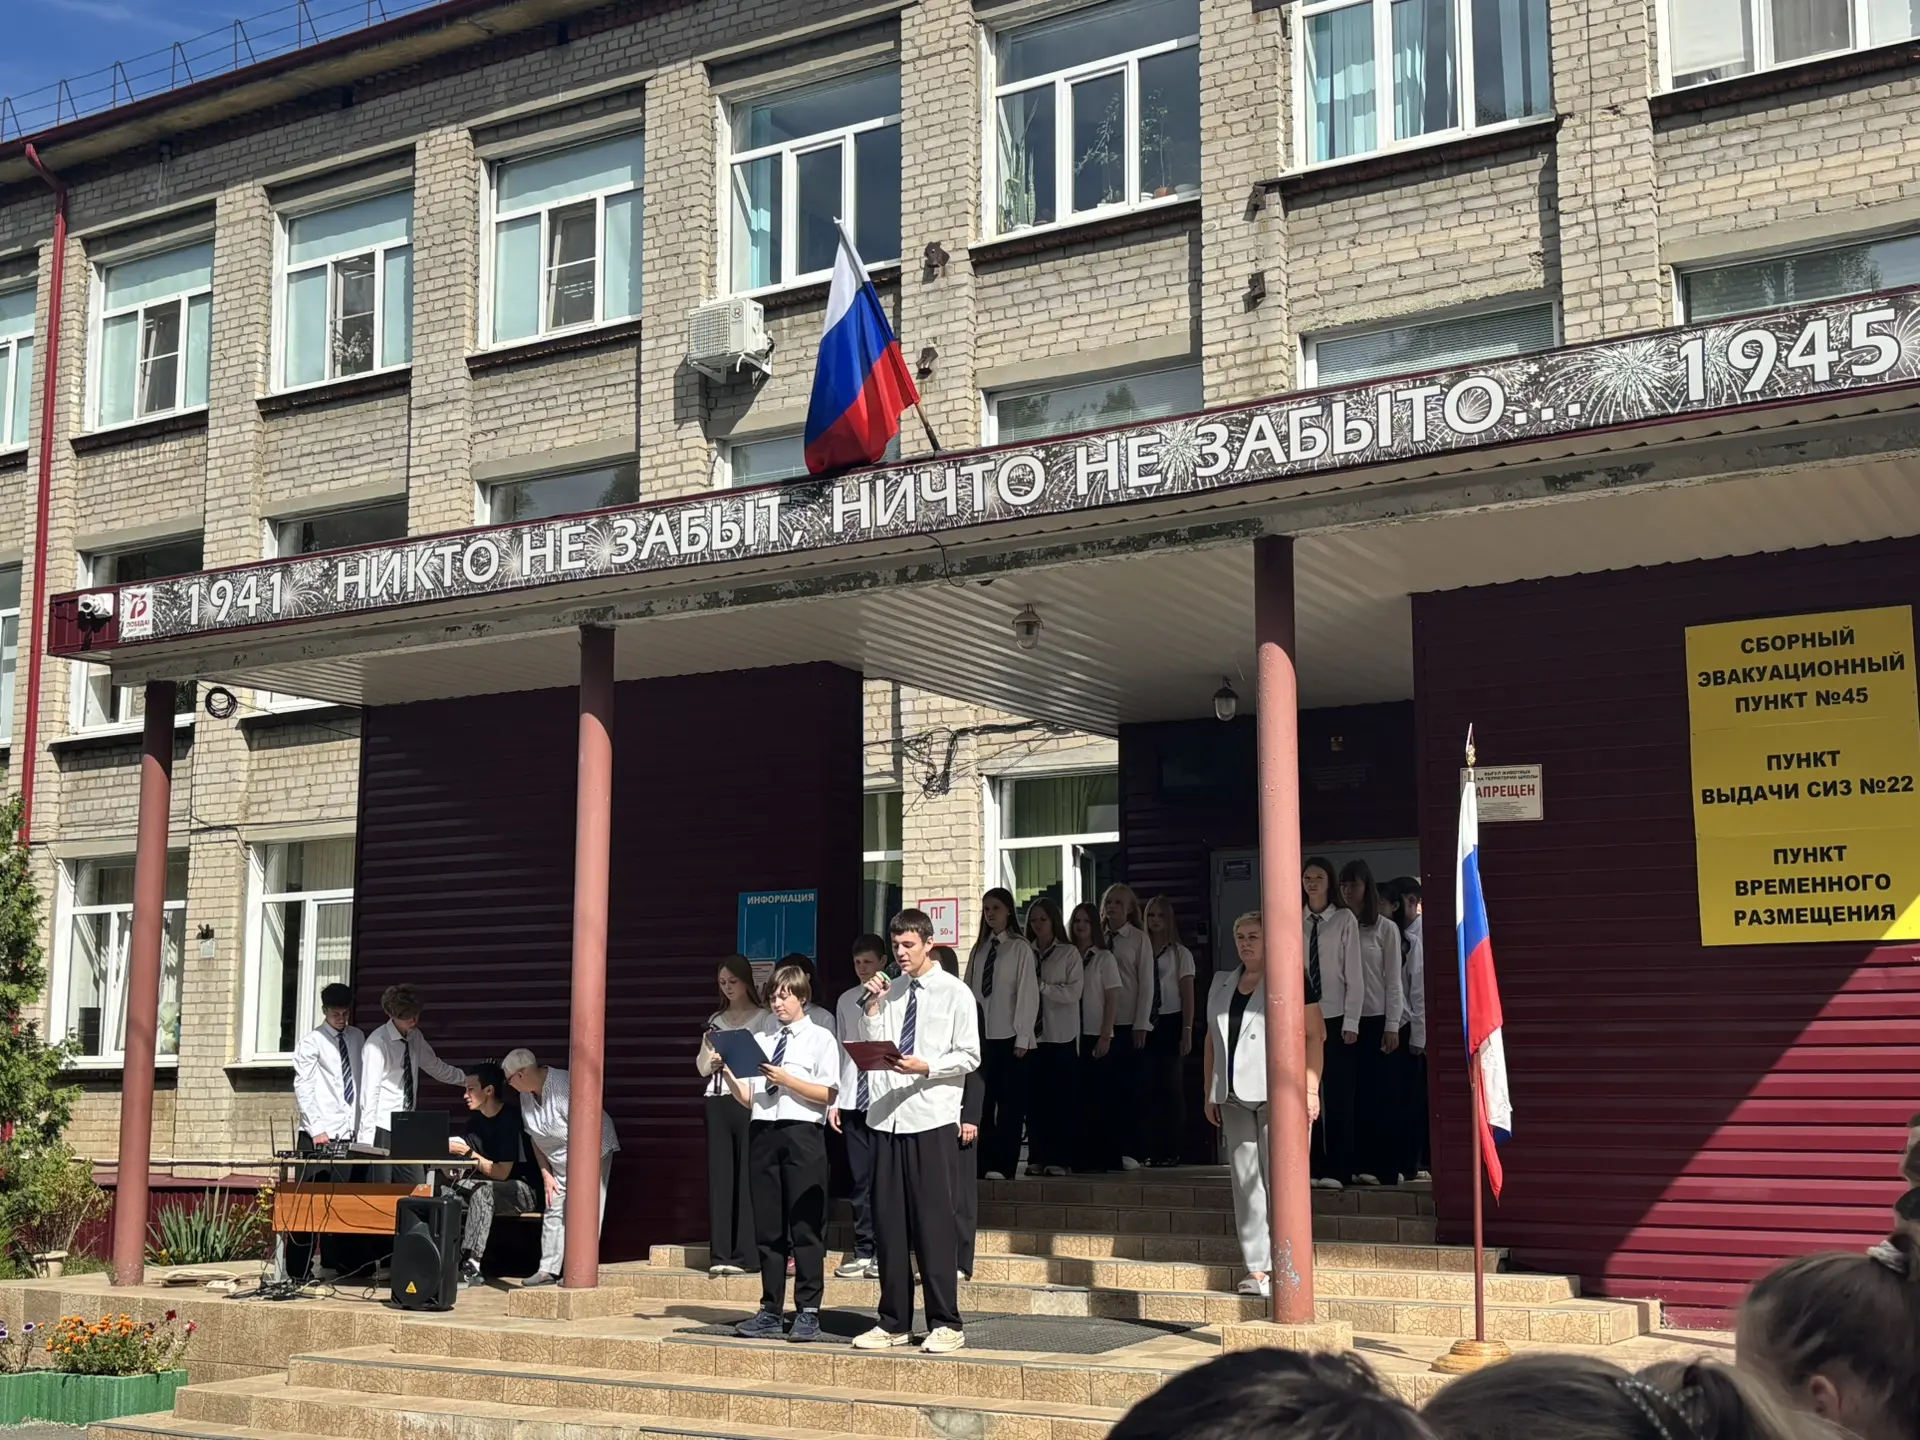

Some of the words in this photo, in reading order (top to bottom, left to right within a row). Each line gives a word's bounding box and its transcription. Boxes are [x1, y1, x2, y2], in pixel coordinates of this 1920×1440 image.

[188, 572, 282, 625] 1941
[337, 540, 499, 601] НИКТО
[522, 525, 586, 576] НЕ
[611, 495, 803, 564] ЗАБЫТ,
[832, 455, 1045, 533] НИЧТО
[1076, 434, 1162, 496] НЕ
[1196, 376, 1582, 477] ЗАБЫТО...
[1678, 308, 1900, 401] 1945
[1741, 626, 1855, 654] СБОРНЫЙ
[1698, 651, 1904, 687] ЭВАКУАЦИОННЫЙ
[1735, 692, 1808, 713] ПУНКТ
[1816, 687, 1868, 706] №45
[1767, 750, 1840, 771] ПУНКТ
[1476, 784, 1535, 798] АПРЕЩЕН
[1702, 783, 1799, 805] ВЫДАЧИ
[1807, 779, 1852, 798] СИЗ
[1860, 775, 1914, 795] №22
[1773, 845, 1847, 865] ПУНКТ
[1735, 873, 1891, 896] ВРЕМЕННОГО
[747, 893, 815, 905] ИНФОРМАЦИЯ
[930, 906, 946, 920] ПГ
[1734, 904, 1896, 926] РАЗМЕЩЕНИЯ
